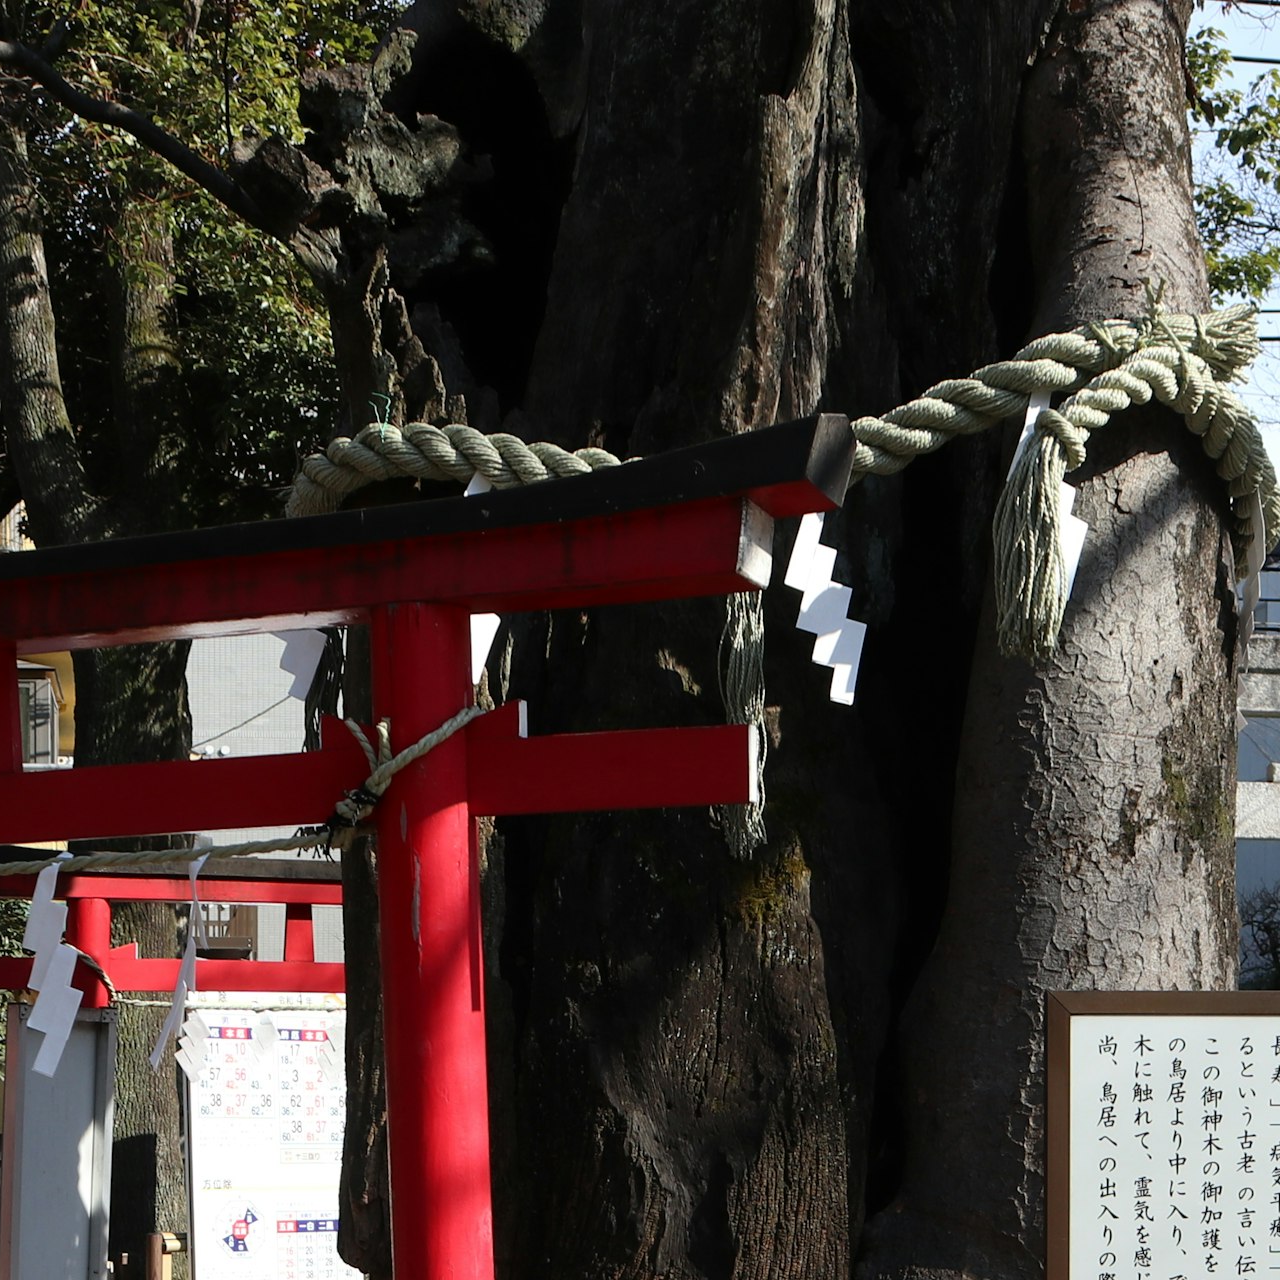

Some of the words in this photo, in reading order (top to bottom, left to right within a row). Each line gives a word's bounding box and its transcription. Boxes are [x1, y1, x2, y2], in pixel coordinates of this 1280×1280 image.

[210, 1043, 220, 1054] 11
[235, 1043, 246, 1055] 10
[290, 1044, 300, 1056] 17
[210, 1068, 221, 1081] 57
[235, 1068, 246, 1081] 56
[292, 1070, 299, 1082] 3
[317, 1071, 323, 1082] 2
[210, 1094, 222, 1107] 38
[236, 1095, 247, 1107] 37
[261, 1094, 272, 1107] 36
[290, 1095, 301, 1107] 62
[315, 1096, 325, 1107] 61
[291, 1121, 302, 1133] 38
[316, 1121, 326, 1133] 37
